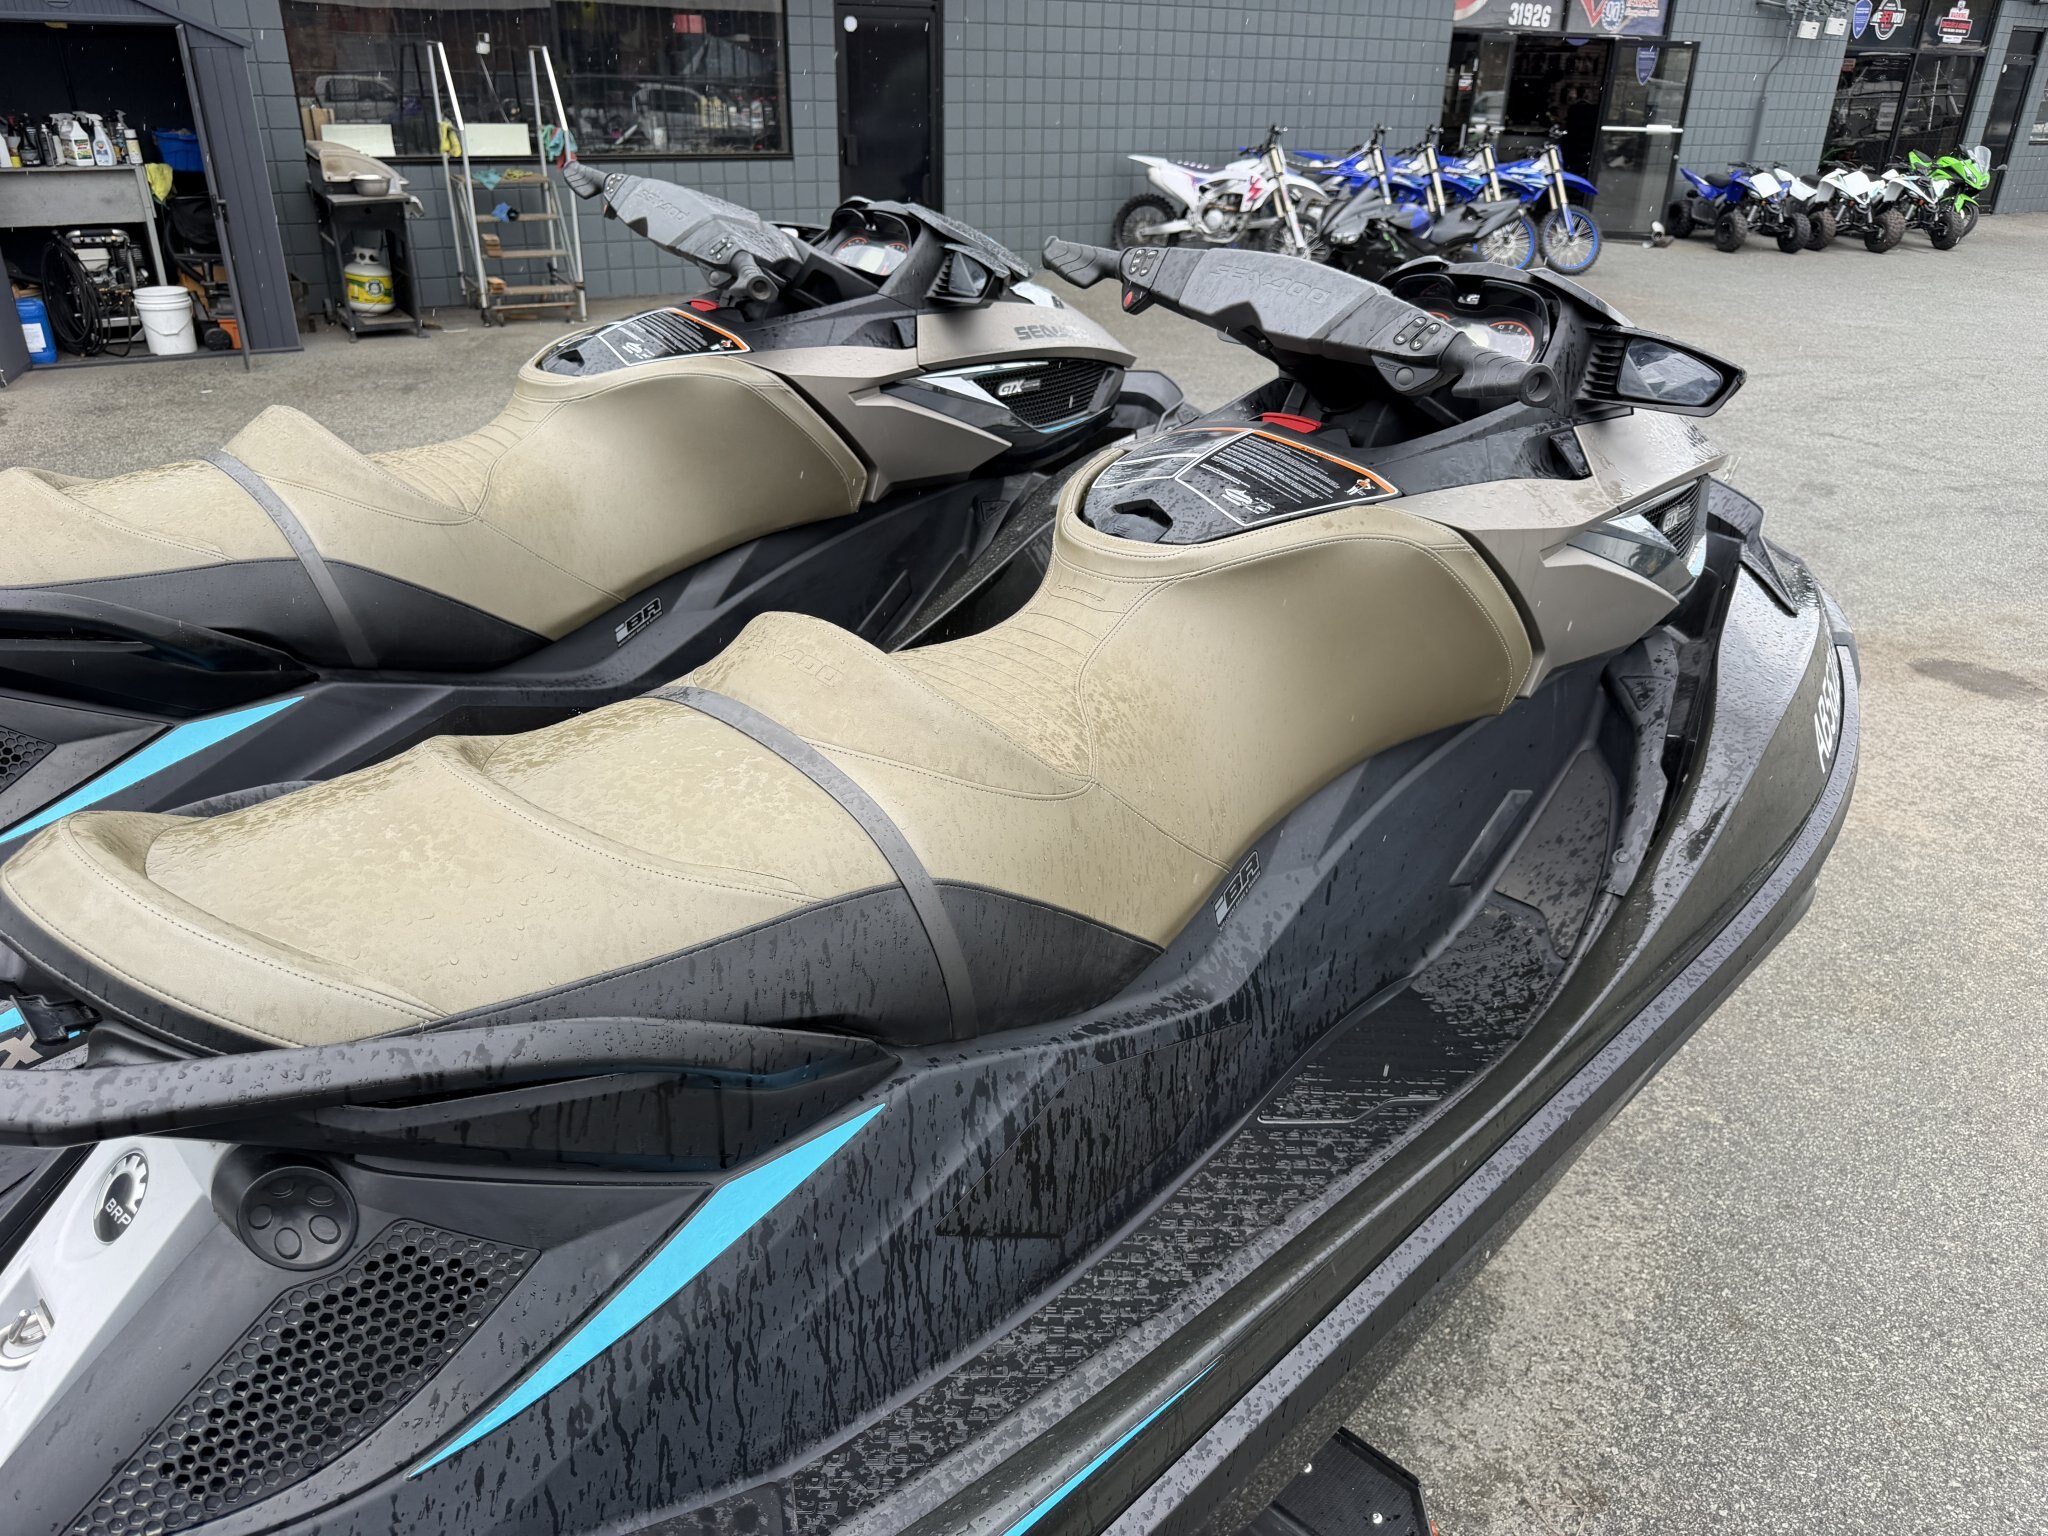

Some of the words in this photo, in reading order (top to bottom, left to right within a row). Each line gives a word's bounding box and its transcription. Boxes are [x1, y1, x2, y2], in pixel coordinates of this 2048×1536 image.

[1508, 2, 1552, 28] 31926
[998, 379, 1025, 396] GTX
[105, 1197, 132, 1226] BRP
